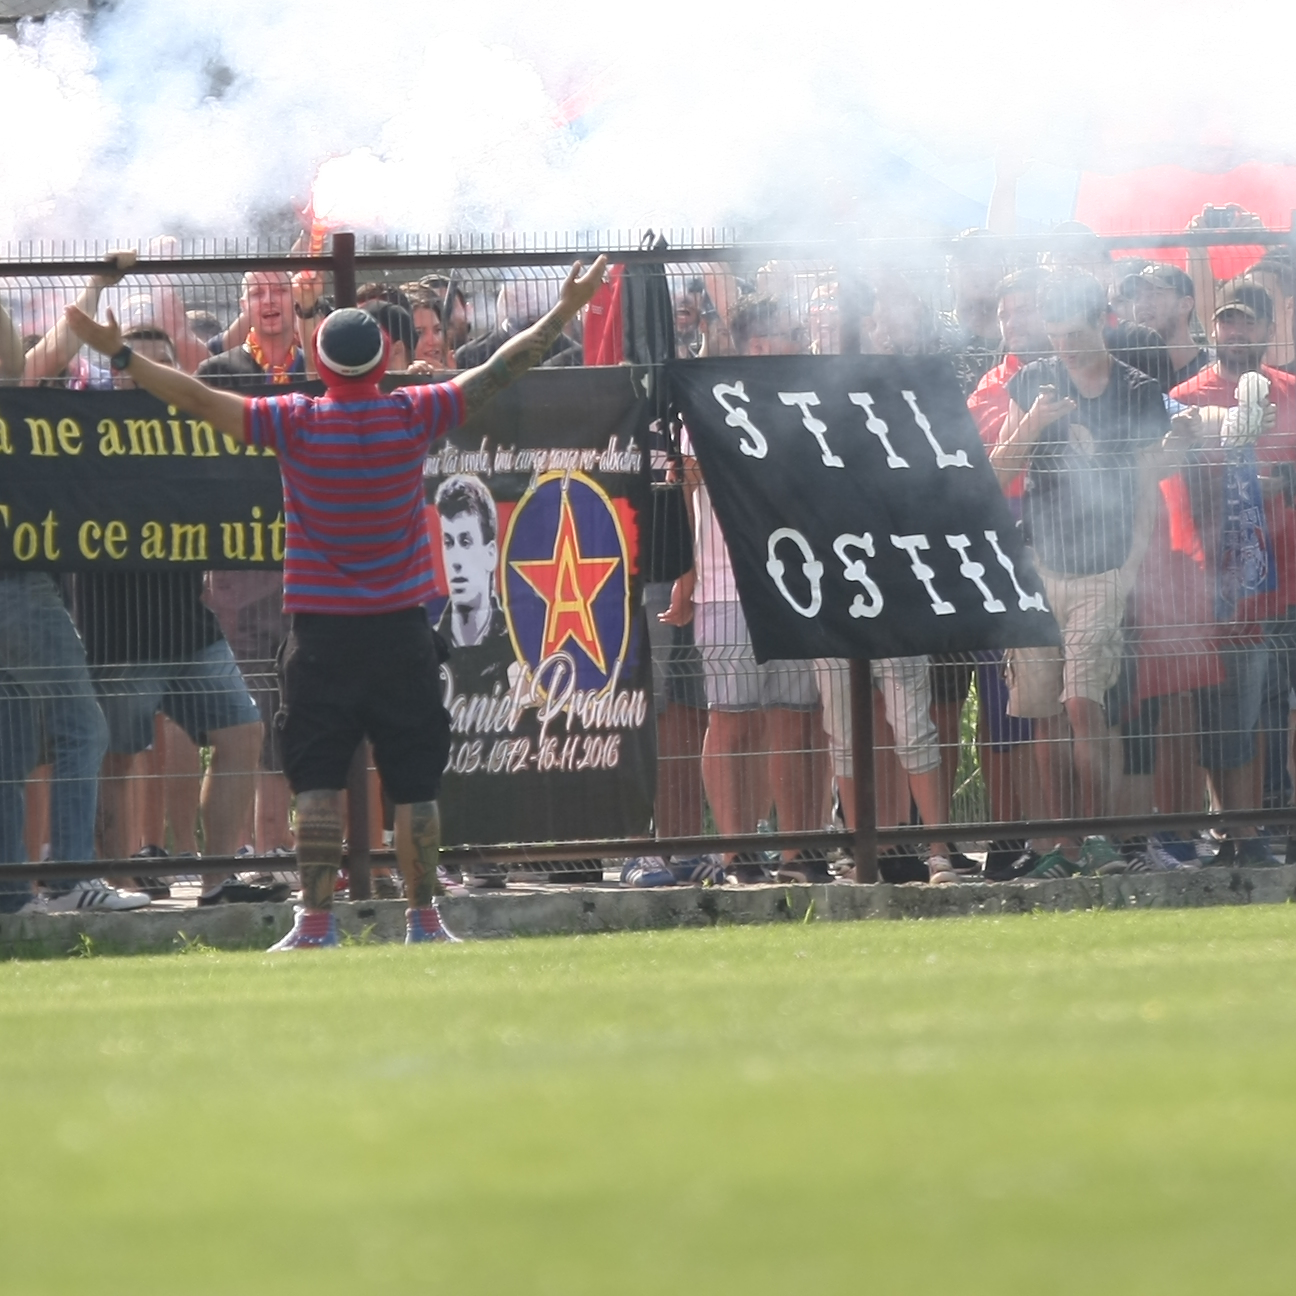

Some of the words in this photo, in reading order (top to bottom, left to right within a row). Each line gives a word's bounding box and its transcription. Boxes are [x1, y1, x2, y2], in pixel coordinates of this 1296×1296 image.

[25, 417, 82, 455] ne
[712, 381, 974, 469] STIL
[78, 520, 128, 560] ce
[140, 520, 207, 561] am
[766, 528, 1049, 618] OSTIL
[529, 650, 649, 752] Prodan
